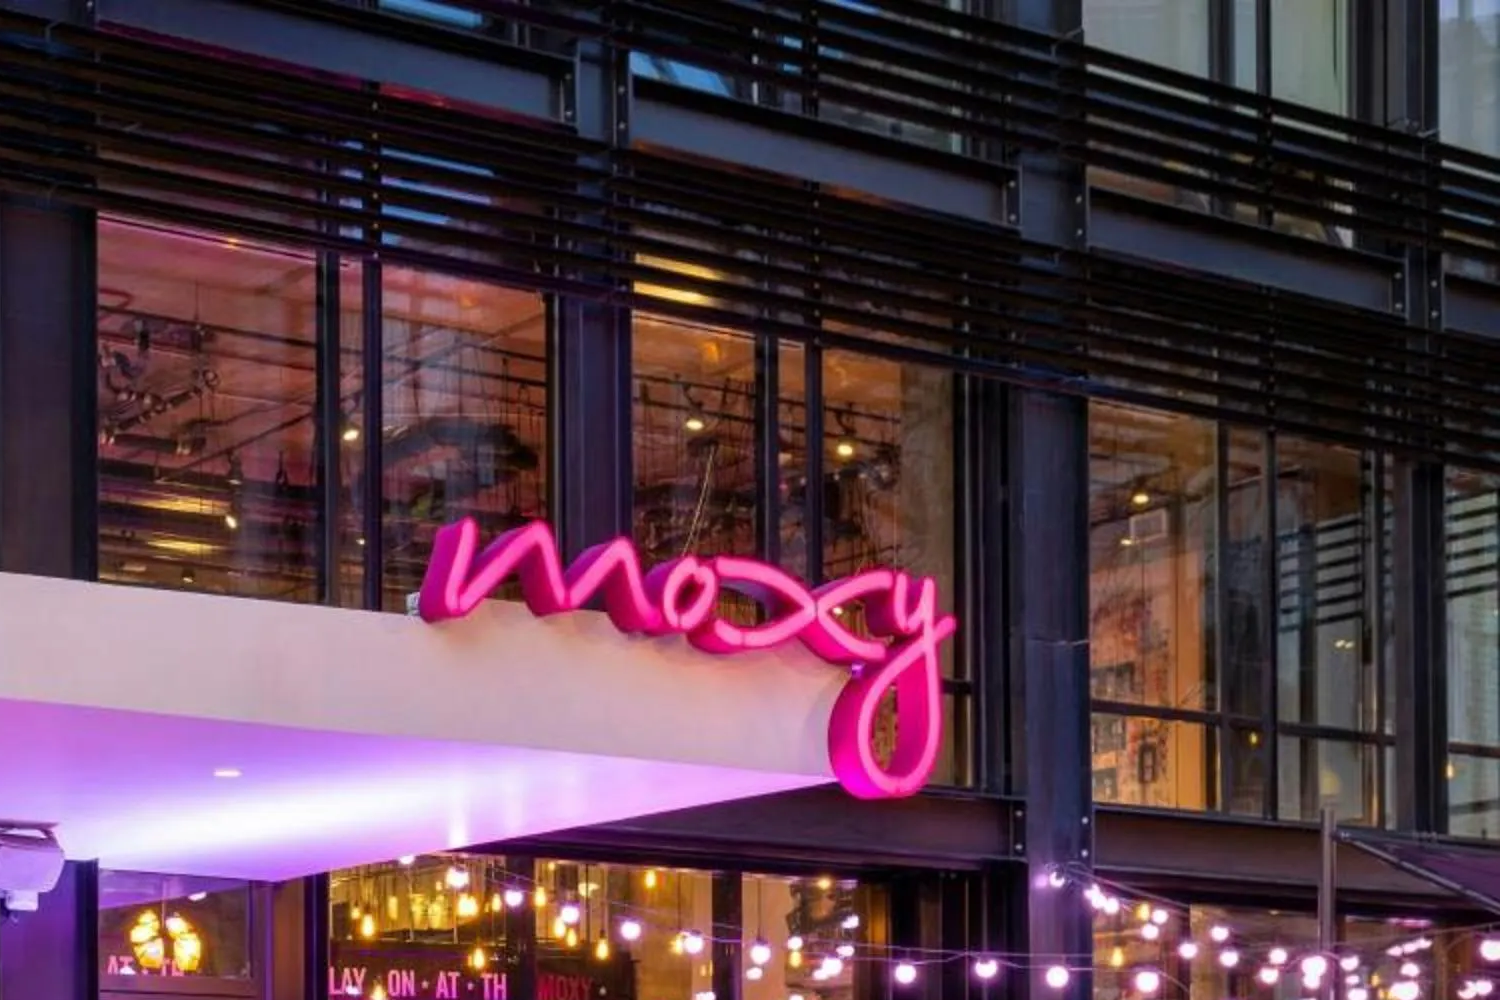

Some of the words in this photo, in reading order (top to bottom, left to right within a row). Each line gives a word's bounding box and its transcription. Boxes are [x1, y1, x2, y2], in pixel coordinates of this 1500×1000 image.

[329, 966, 366, 995] LAY
[387, 969, 415, 997] ON
[436, 971, 461, 999] AT
[480, 973, 507, 1000] TH
